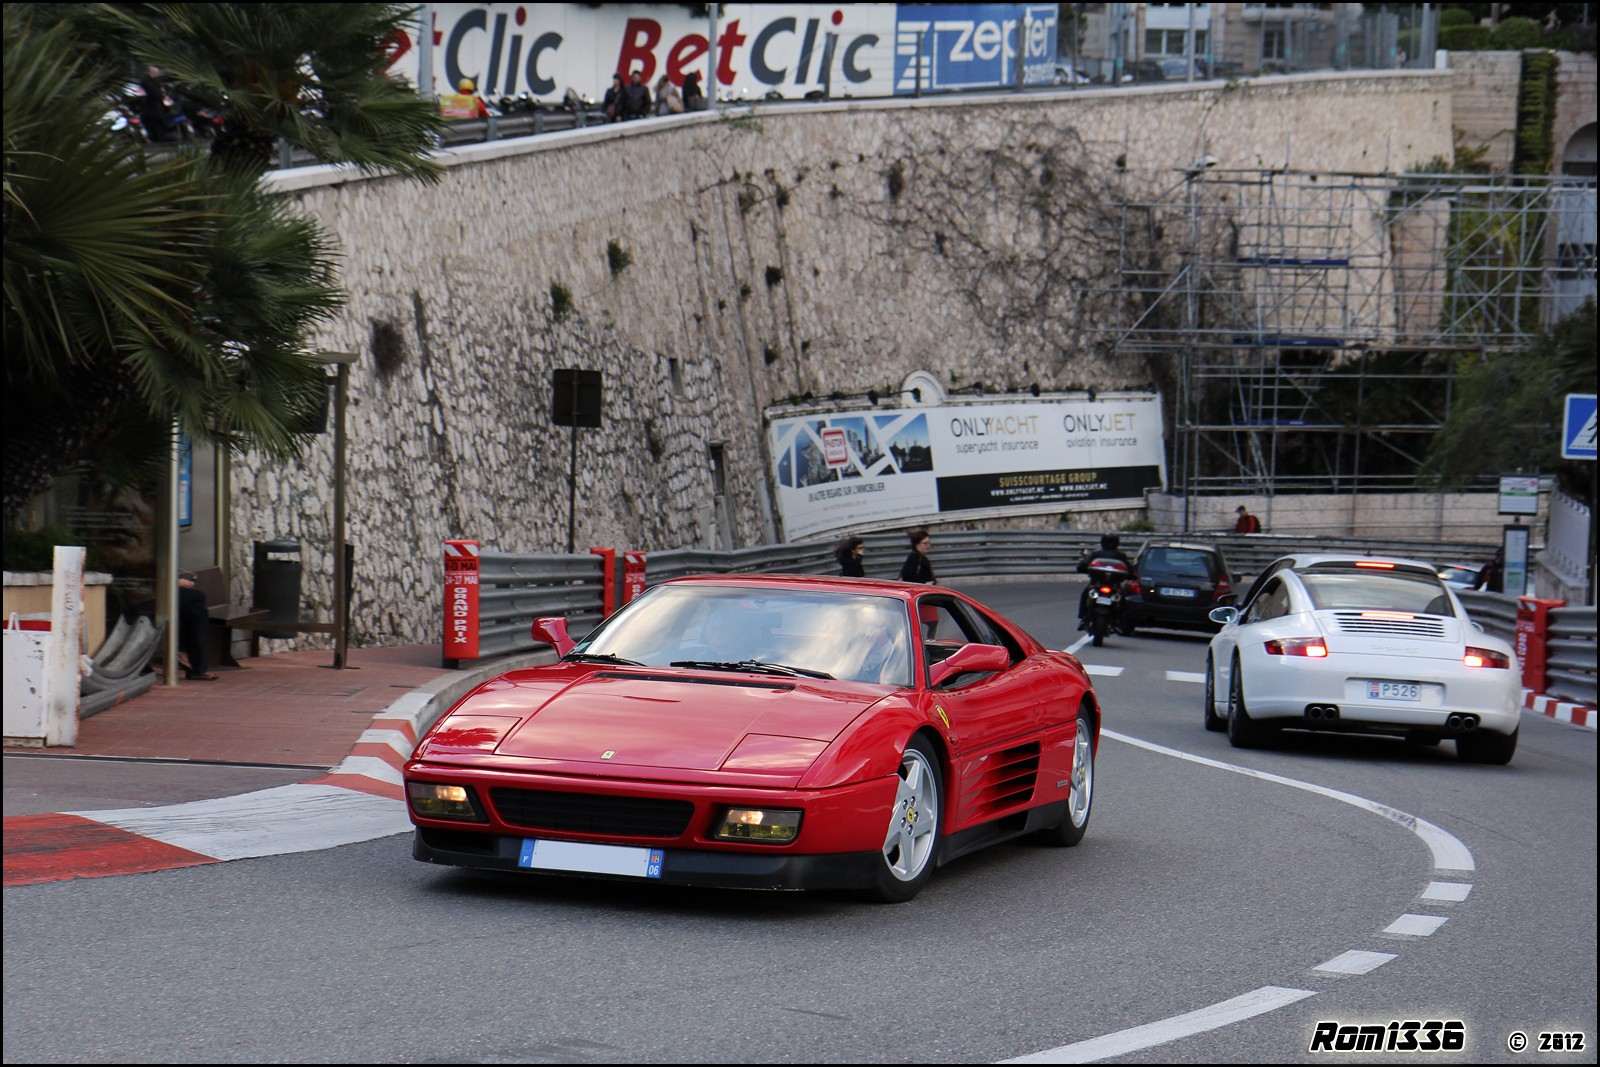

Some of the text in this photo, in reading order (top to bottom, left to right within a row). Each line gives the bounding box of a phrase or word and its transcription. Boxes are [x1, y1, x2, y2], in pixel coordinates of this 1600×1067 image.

[616, 9, 880, 87] BetClic
[1063, 412, 1137, 433] ONLYJET
[1001, 440, 1039, 451] insurance
[1066, 436, 1138, 449] aviation insurance
[999, 472, 1098, 488] SUISSCOURTAGE GROUP
[453, 587, 468, 617] GRAND
[454, 620, 467, 644] PRIX
[1382, 683, 1418, 698] P526
[648, 865, 659, 876] 06
